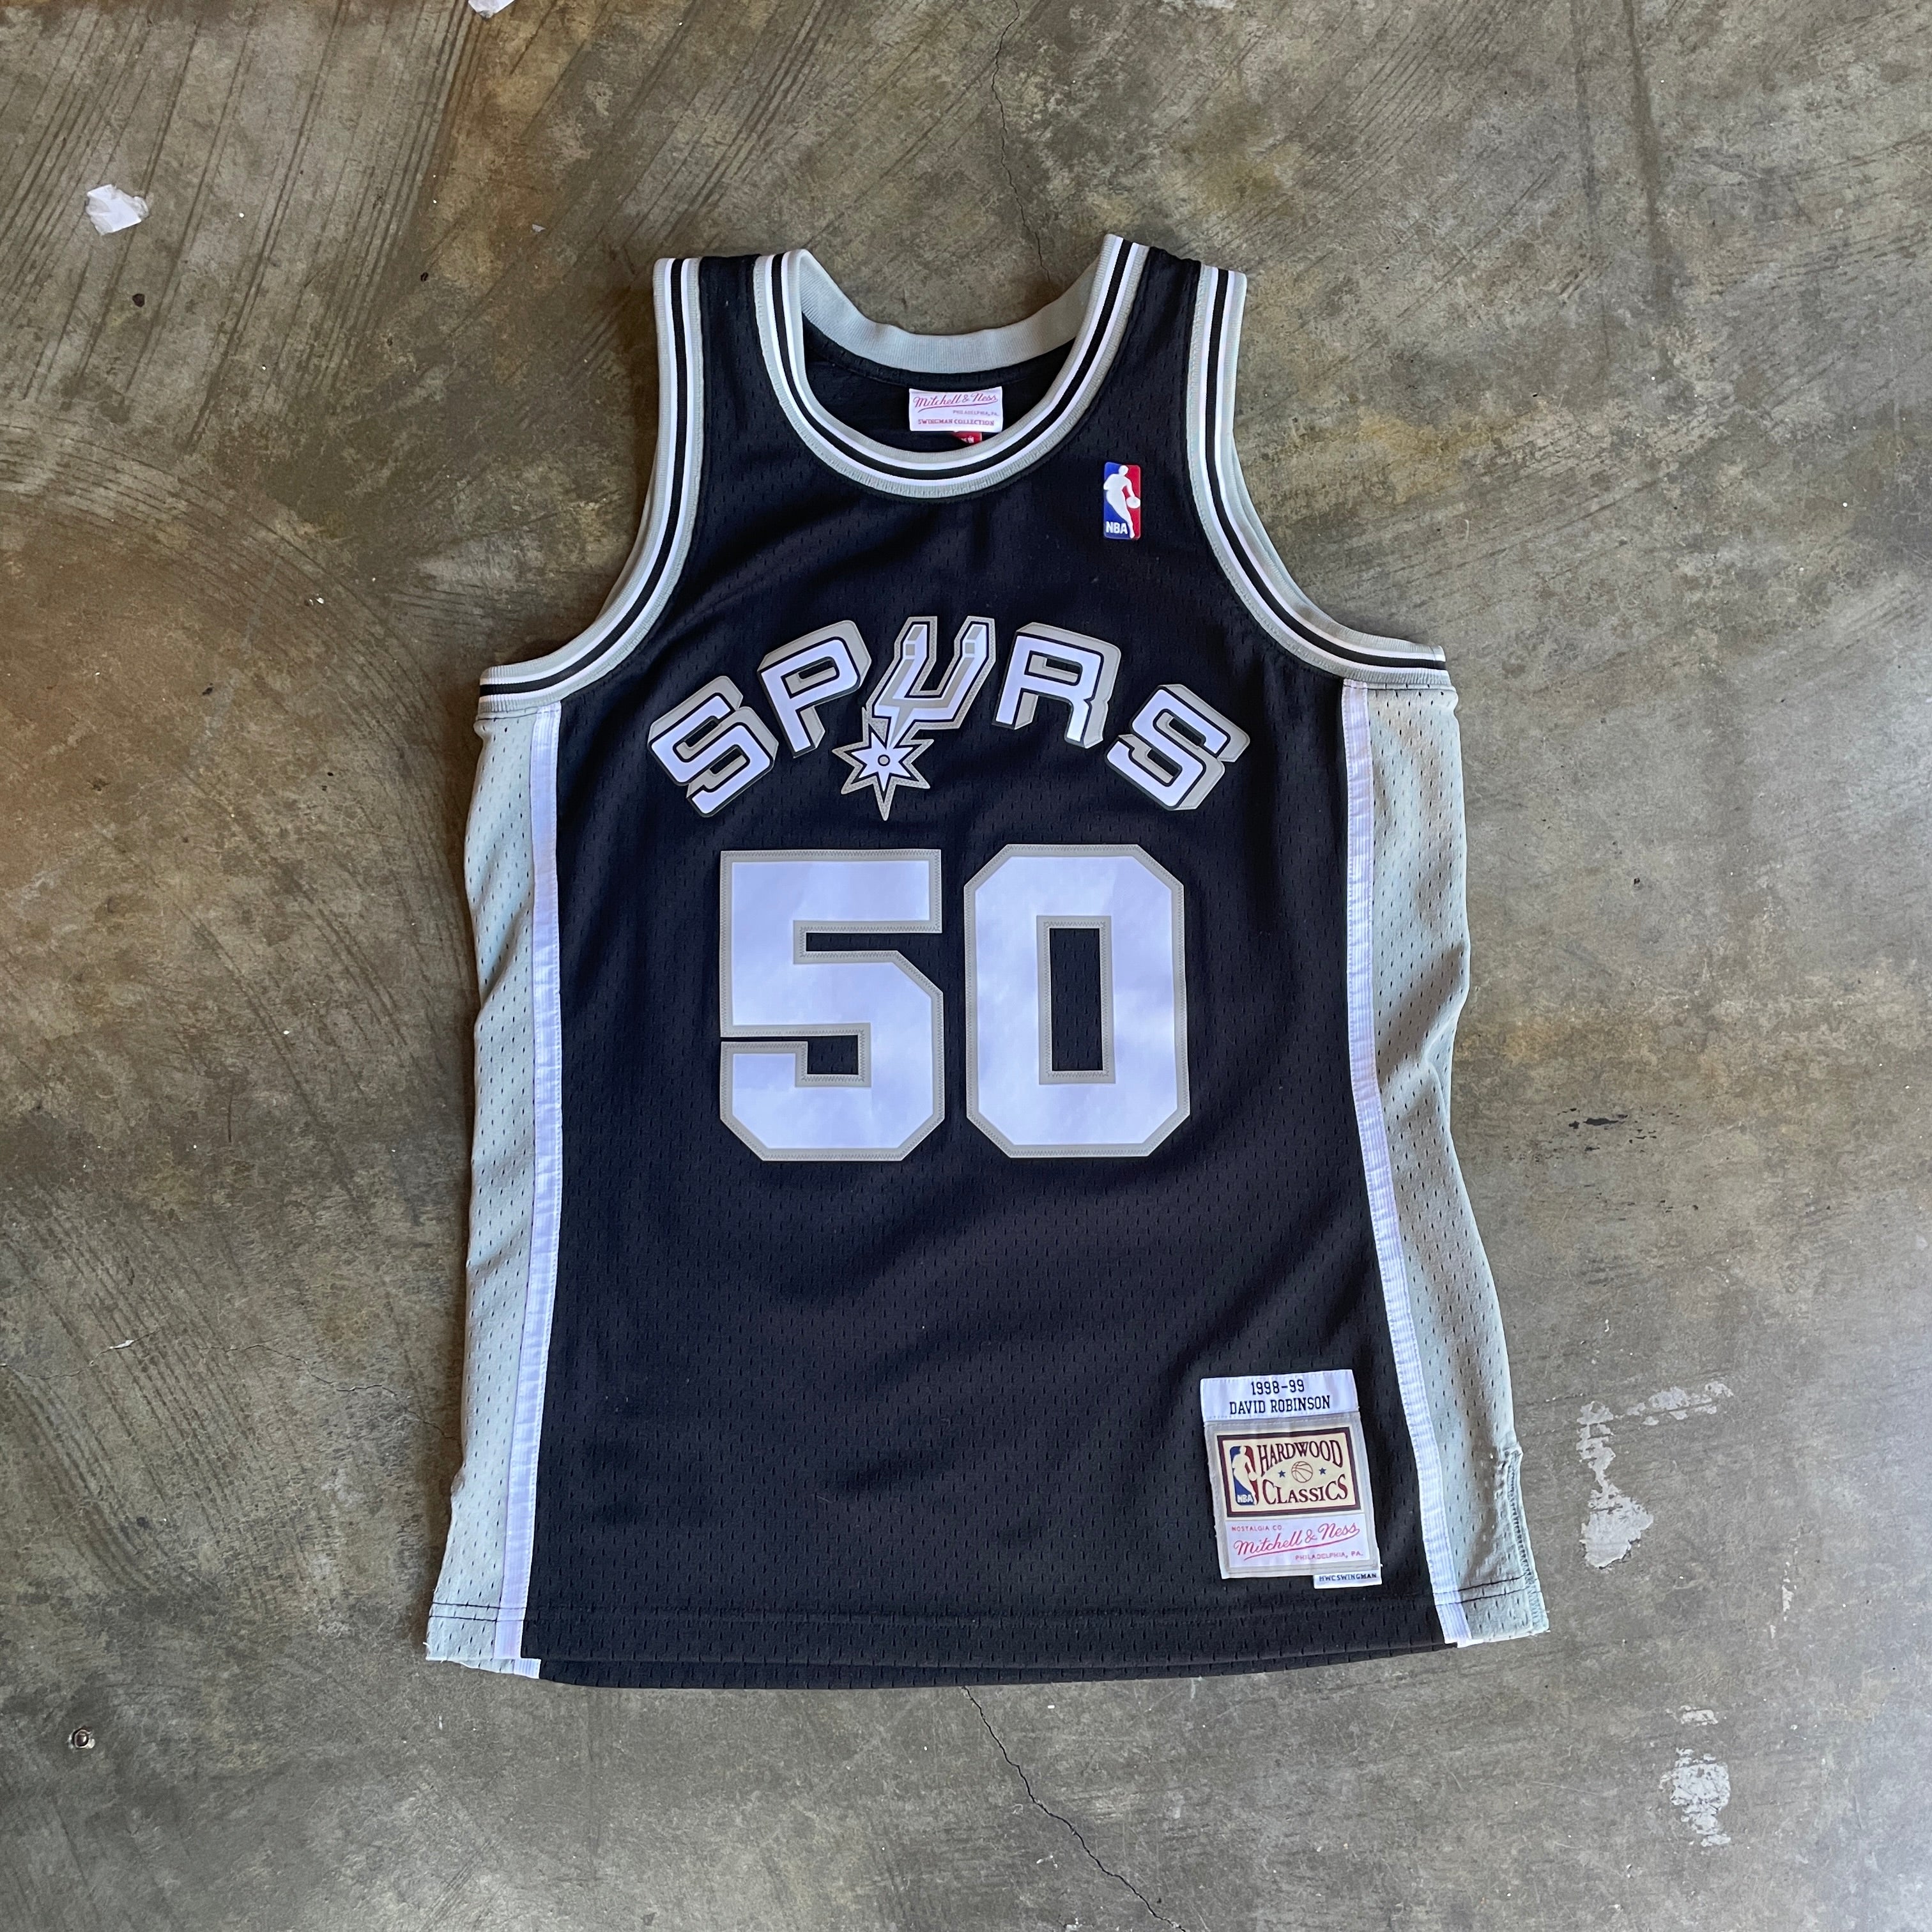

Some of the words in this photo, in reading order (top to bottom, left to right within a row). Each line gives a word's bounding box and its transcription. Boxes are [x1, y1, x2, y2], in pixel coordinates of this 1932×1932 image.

[914, 394, 962, 408] Mitchell
[962, 394, 970, 403] &
[970, 393, 998, 402] Ness
[1106, 521, 1128, 535] NBA
[647, 615, 1251, 821] SPURS
[720, 843, 1190, 1162] 50
[1251, 1379, 1305, 1395] 1998-99
[1229, 1400, 1266, 1414] DAVID
[1271, 1395, 1331, 1413] ROBINSON
[1257, 1439, 1344, 1477] HARDWOOD
[1237, 1494, 1254, 1503] NBA
[1262, 1474, 1348, 1505] CLASSICS
[1234, 1529, 1303, 1555] Mitchell
[1305, 1529, 1317, 1544] &
[1318, 1522, 1360, 1540] Ness
[1295, 1551, 1348, 1560] PHILADELPHIA,
